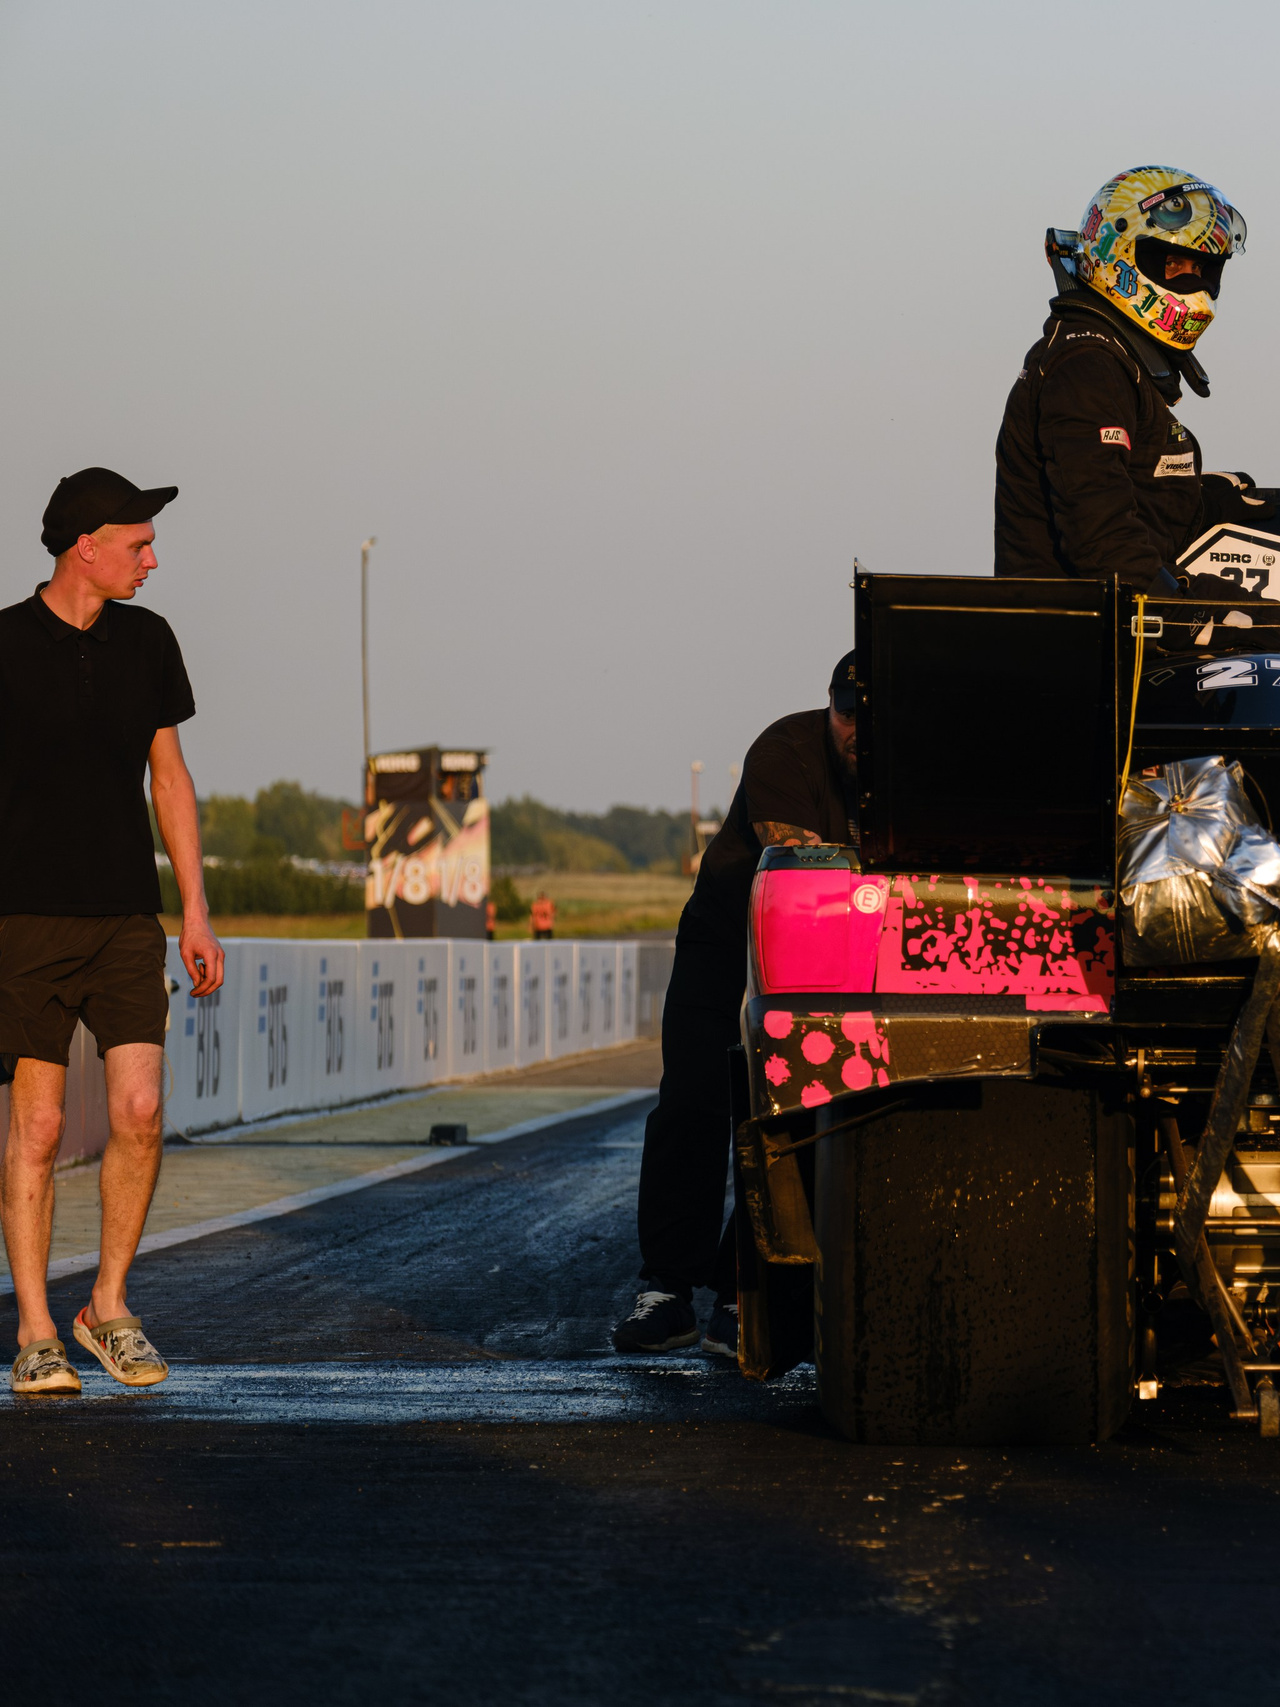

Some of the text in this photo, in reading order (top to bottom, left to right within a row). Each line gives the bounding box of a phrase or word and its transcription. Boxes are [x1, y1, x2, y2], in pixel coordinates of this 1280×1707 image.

[1209, 552, 1252, 564] RDRC
[369, 856, 430, 909] 1/8
[438, 855, 485, 908] 1/8
